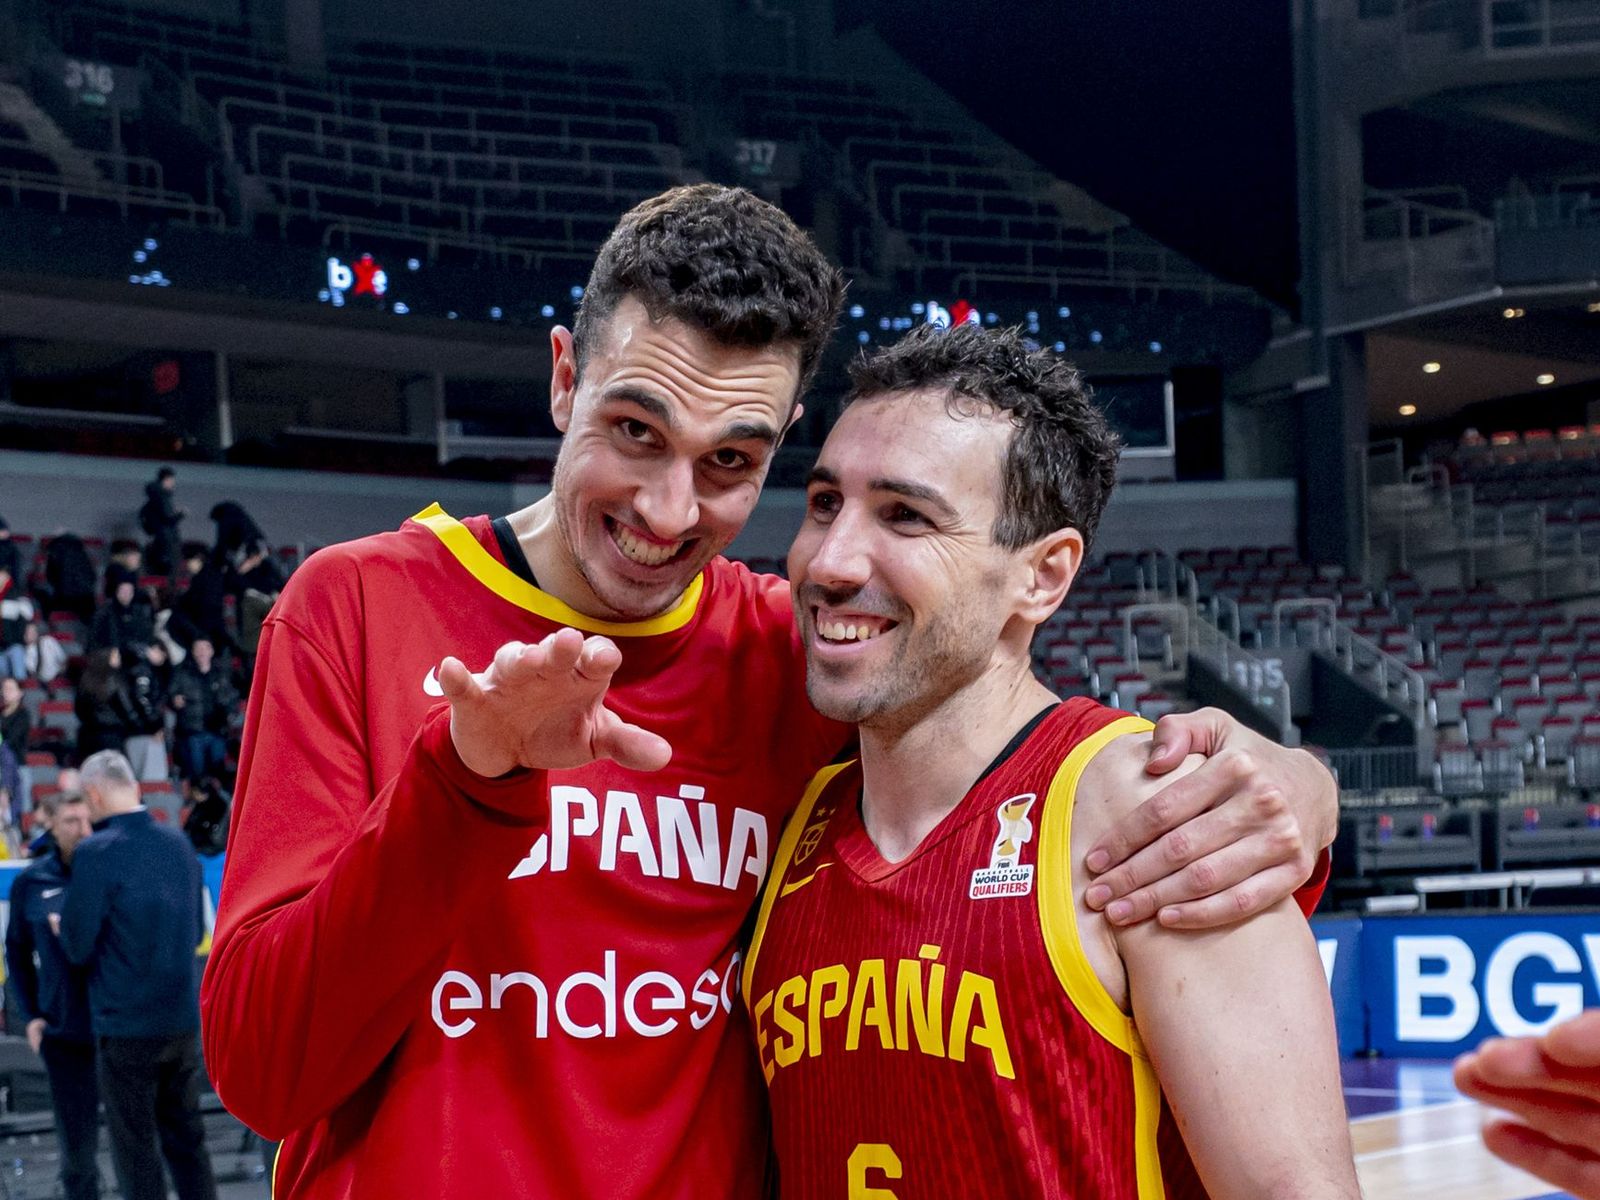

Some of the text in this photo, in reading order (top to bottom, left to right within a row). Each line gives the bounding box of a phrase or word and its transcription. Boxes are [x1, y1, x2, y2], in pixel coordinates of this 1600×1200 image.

[1234, 658, 1284, 691] 115
[508, 784, 769, 896] PAÑA
[972, 882, 1028, 897] QUALIFIERS
[975, 873, 1029, 884] WORLD CUP
[753, 943, 1016, 1088] ESPAÑA
[1394, 931, 1600, 1042] BG
